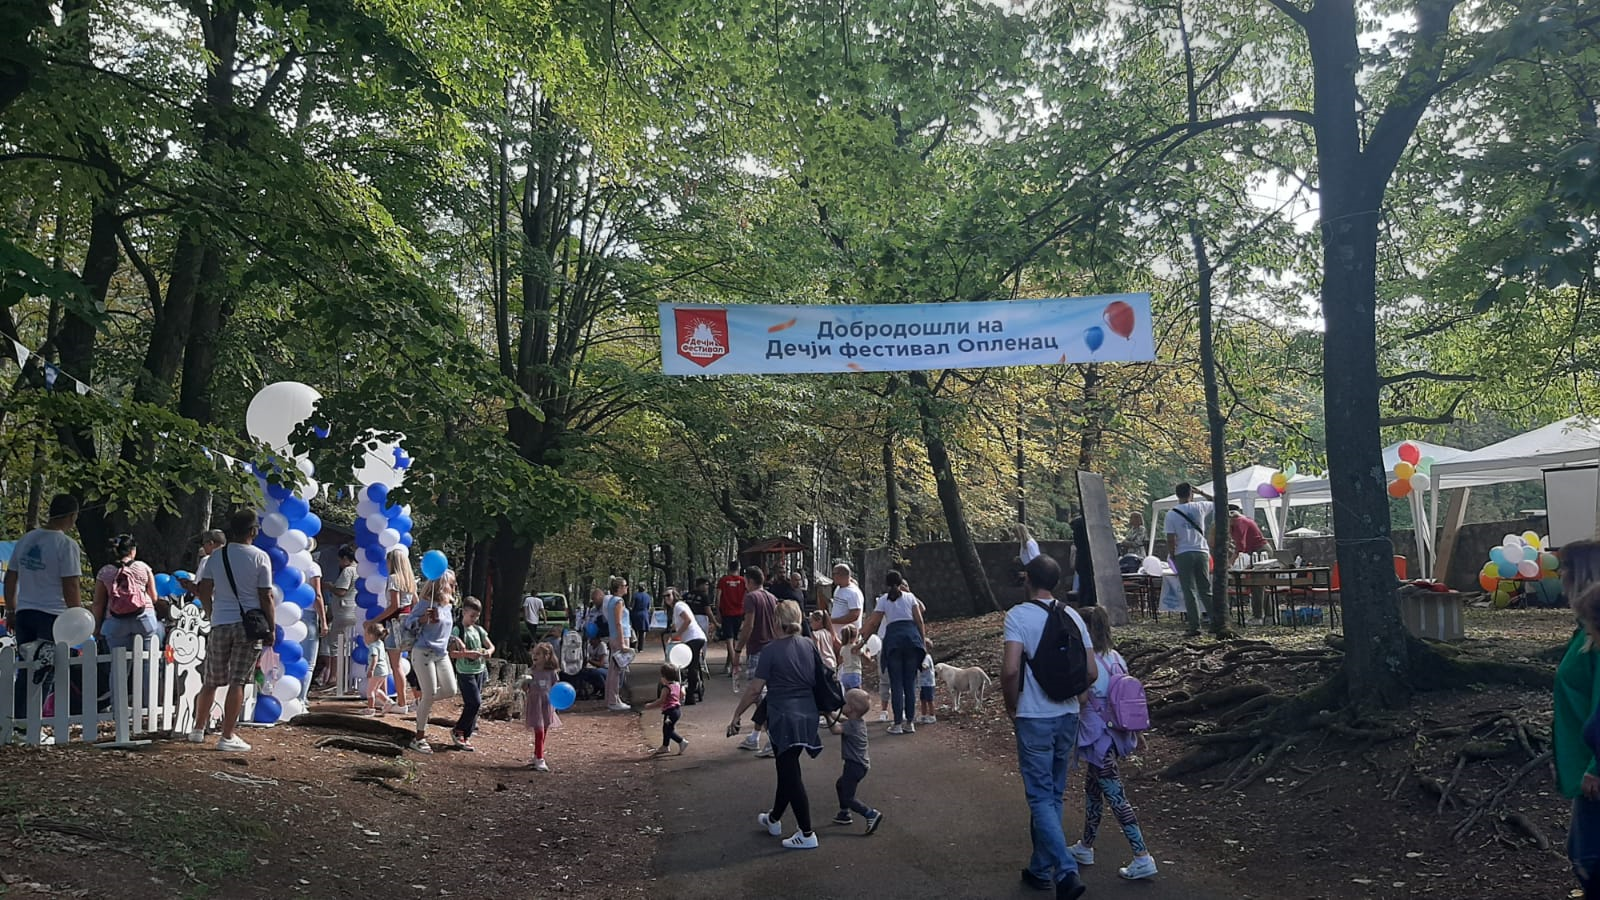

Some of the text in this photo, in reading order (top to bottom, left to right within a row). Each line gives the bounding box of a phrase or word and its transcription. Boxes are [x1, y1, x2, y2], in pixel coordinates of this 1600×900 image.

[817, 320, 1003, 340] Добродошли на
[765, 335, 1058, 360] Дечји фестивал Опленац
